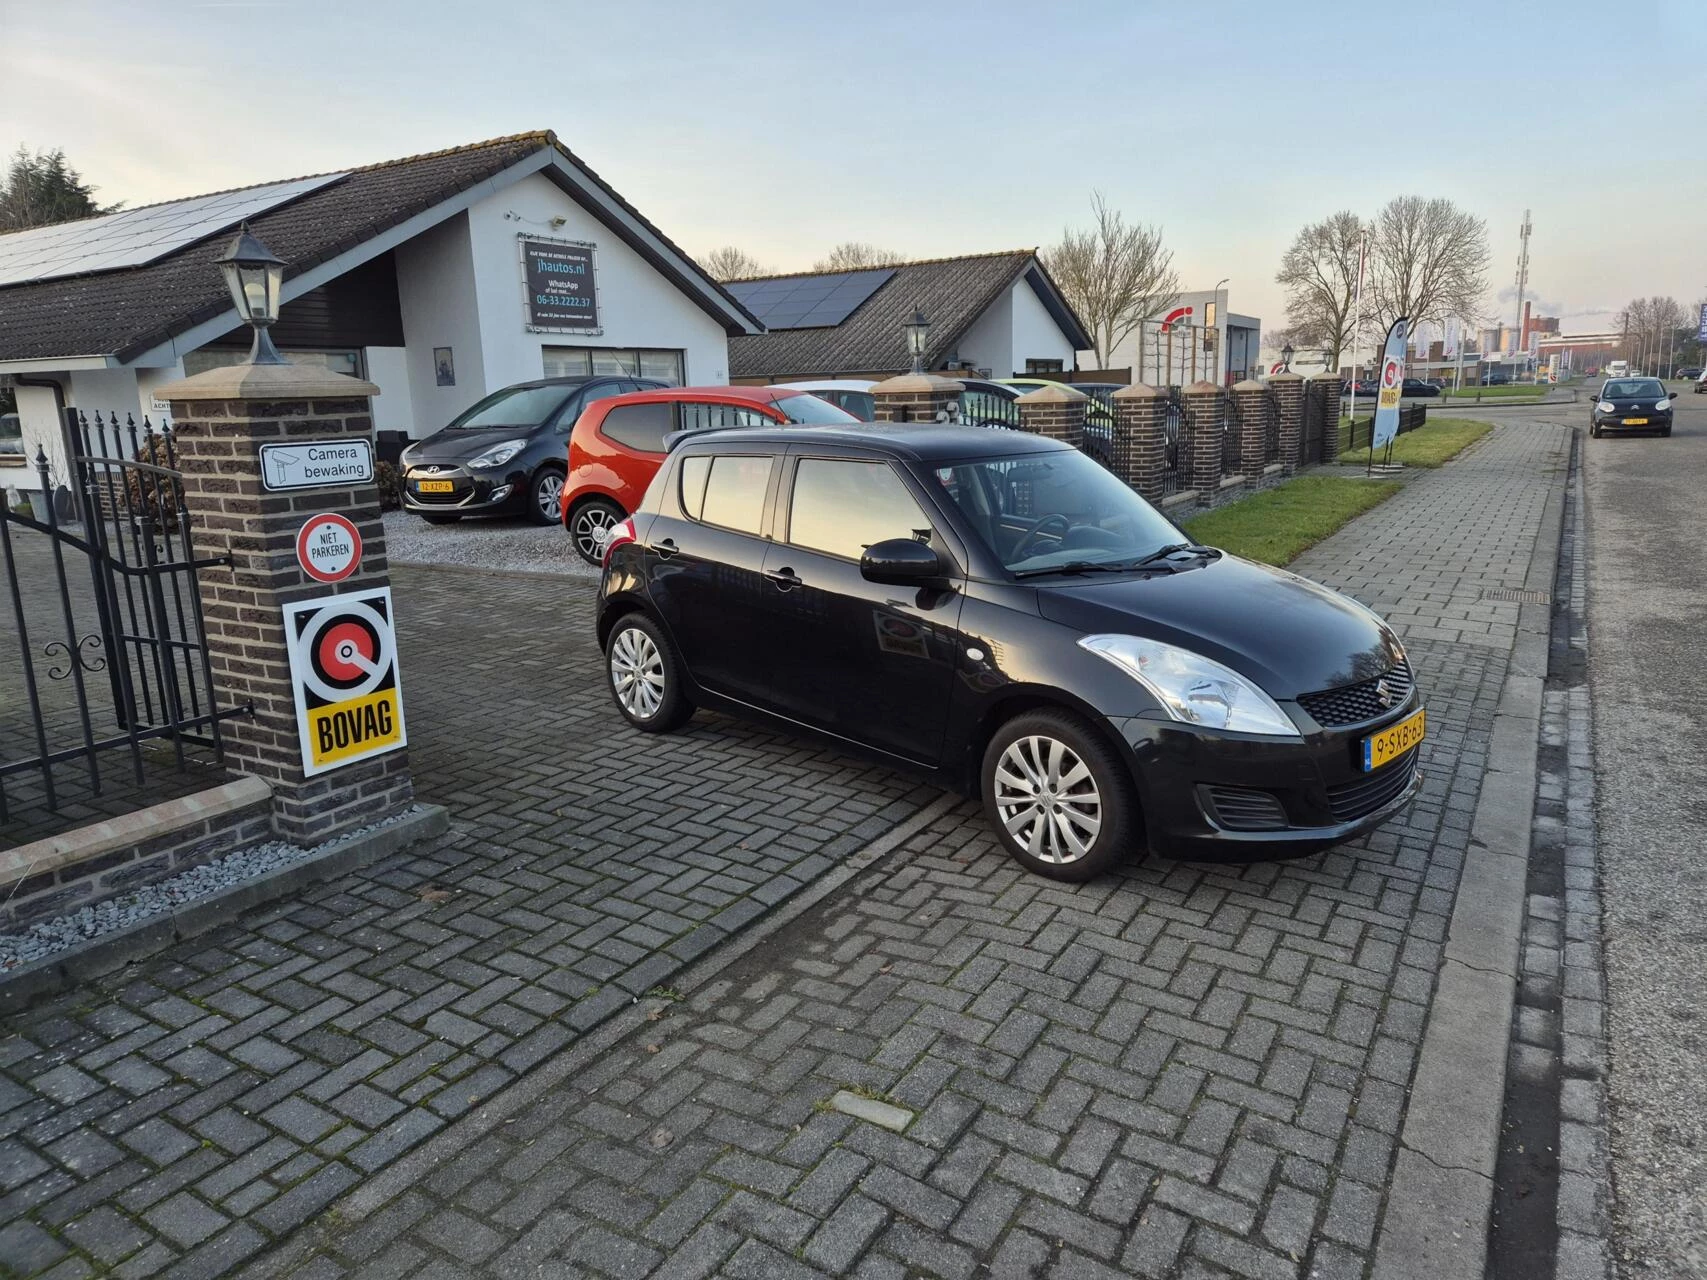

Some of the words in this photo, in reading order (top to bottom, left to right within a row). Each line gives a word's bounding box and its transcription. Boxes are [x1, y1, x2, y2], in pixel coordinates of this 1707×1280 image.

[537, 258, 585, 275] jhautos.nl
[548, 279, 578, 290] WhatsApp
[536, 294, 590, 307] 06-33.2222.37
[308, 448, 357, 461] Camera
[304, 464, 364, 478] bewaking
[320, 532, 337, 545] NIET
[311, 544, 350, 559] PARKEREN
[317, 700, 393, 754] BOVAG
[1377, 716, 1423, 761] 9-SXB-63
